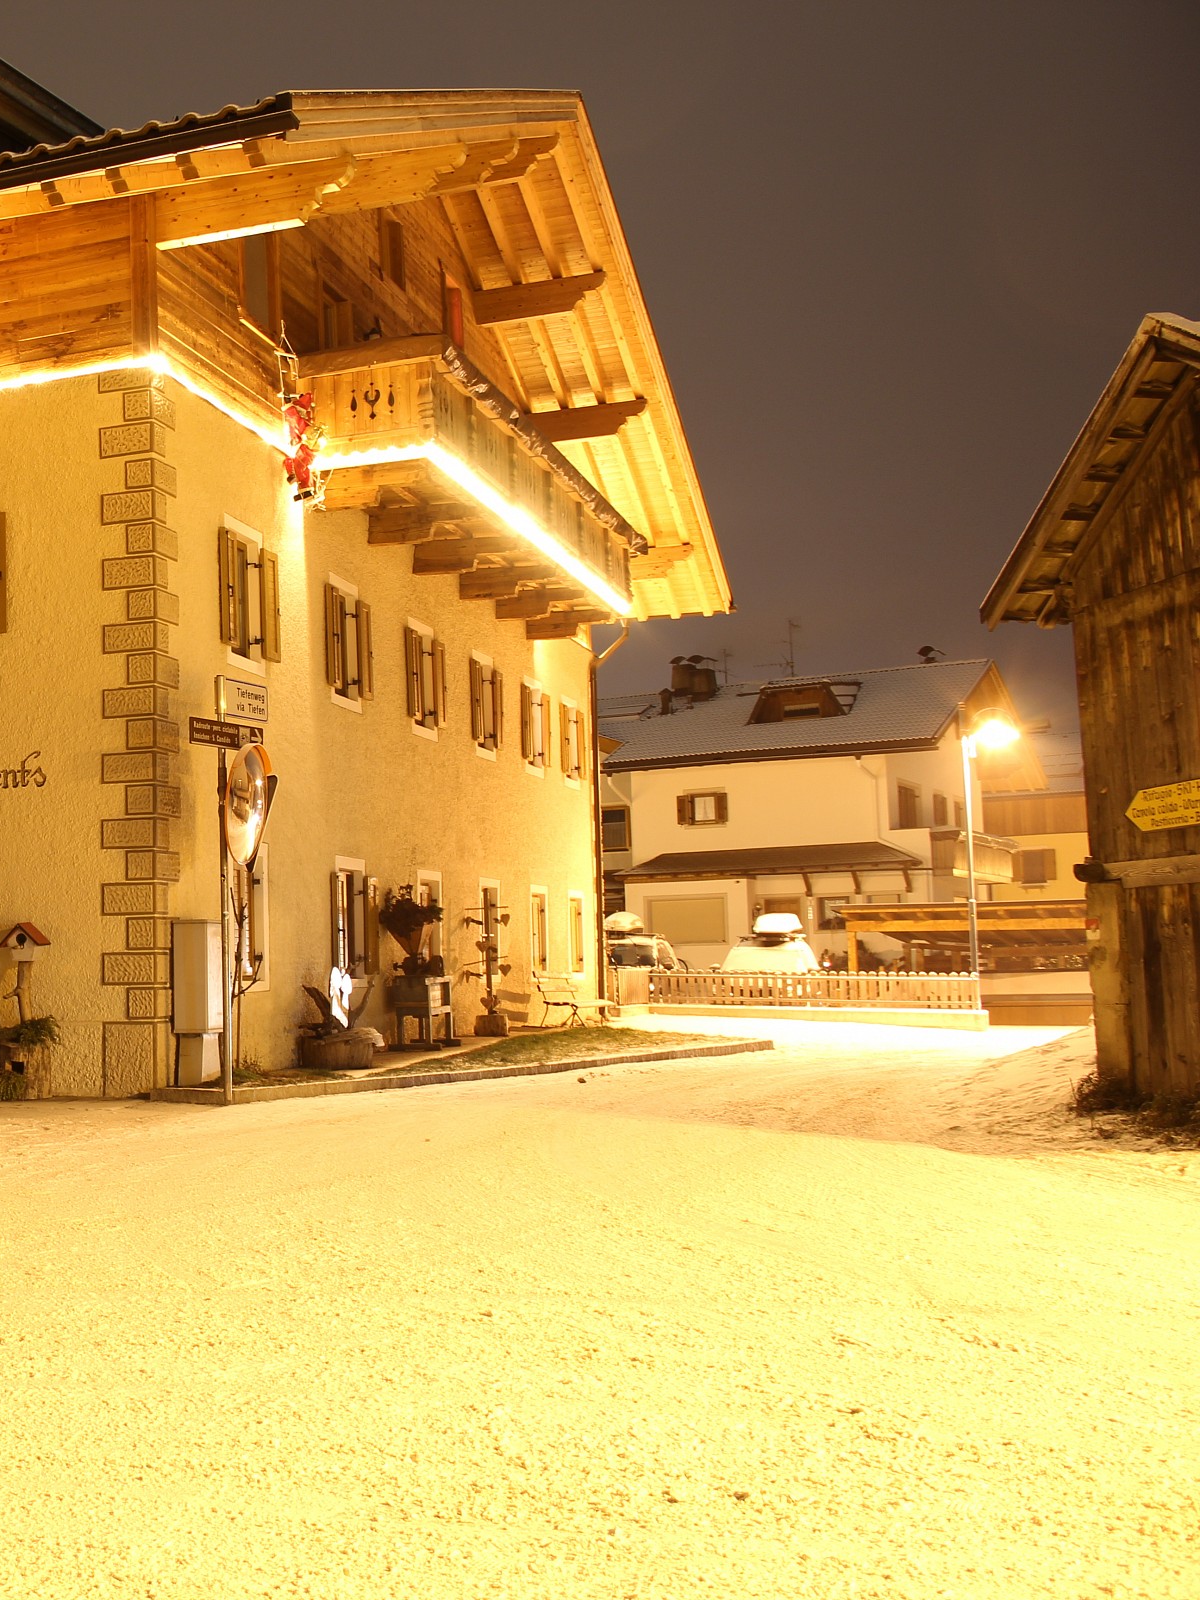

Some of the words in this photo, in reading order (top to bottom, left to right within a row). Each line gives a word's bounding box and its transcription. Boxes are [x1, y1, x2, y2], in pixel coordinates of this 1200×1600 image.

[236, 687, 265, 704] Tiefenweg
[236, 702, 245, 712] via
[248, 703, 265, 715] Tiefen
